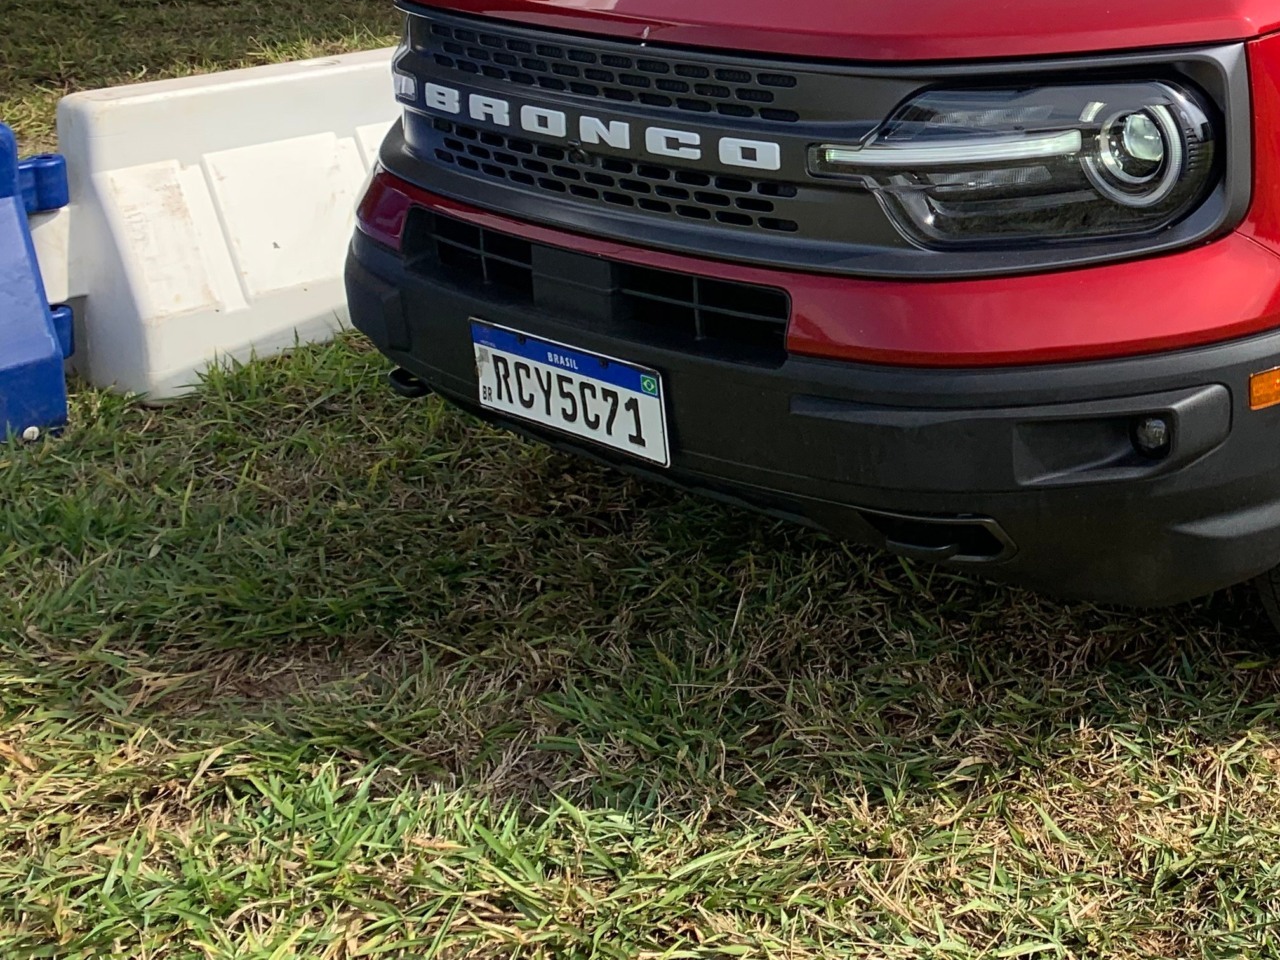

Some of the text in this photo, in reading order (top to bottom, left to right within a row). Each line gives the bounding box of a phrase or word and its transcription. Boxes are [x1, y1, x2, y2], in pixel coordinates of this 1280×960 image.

[425, 82, 781, 170] BRONCO
[546, 351, 579, 371] BRASIL
[482, 384, 493, 403] BR
[491, 353, 647, 448] RCY5C71
